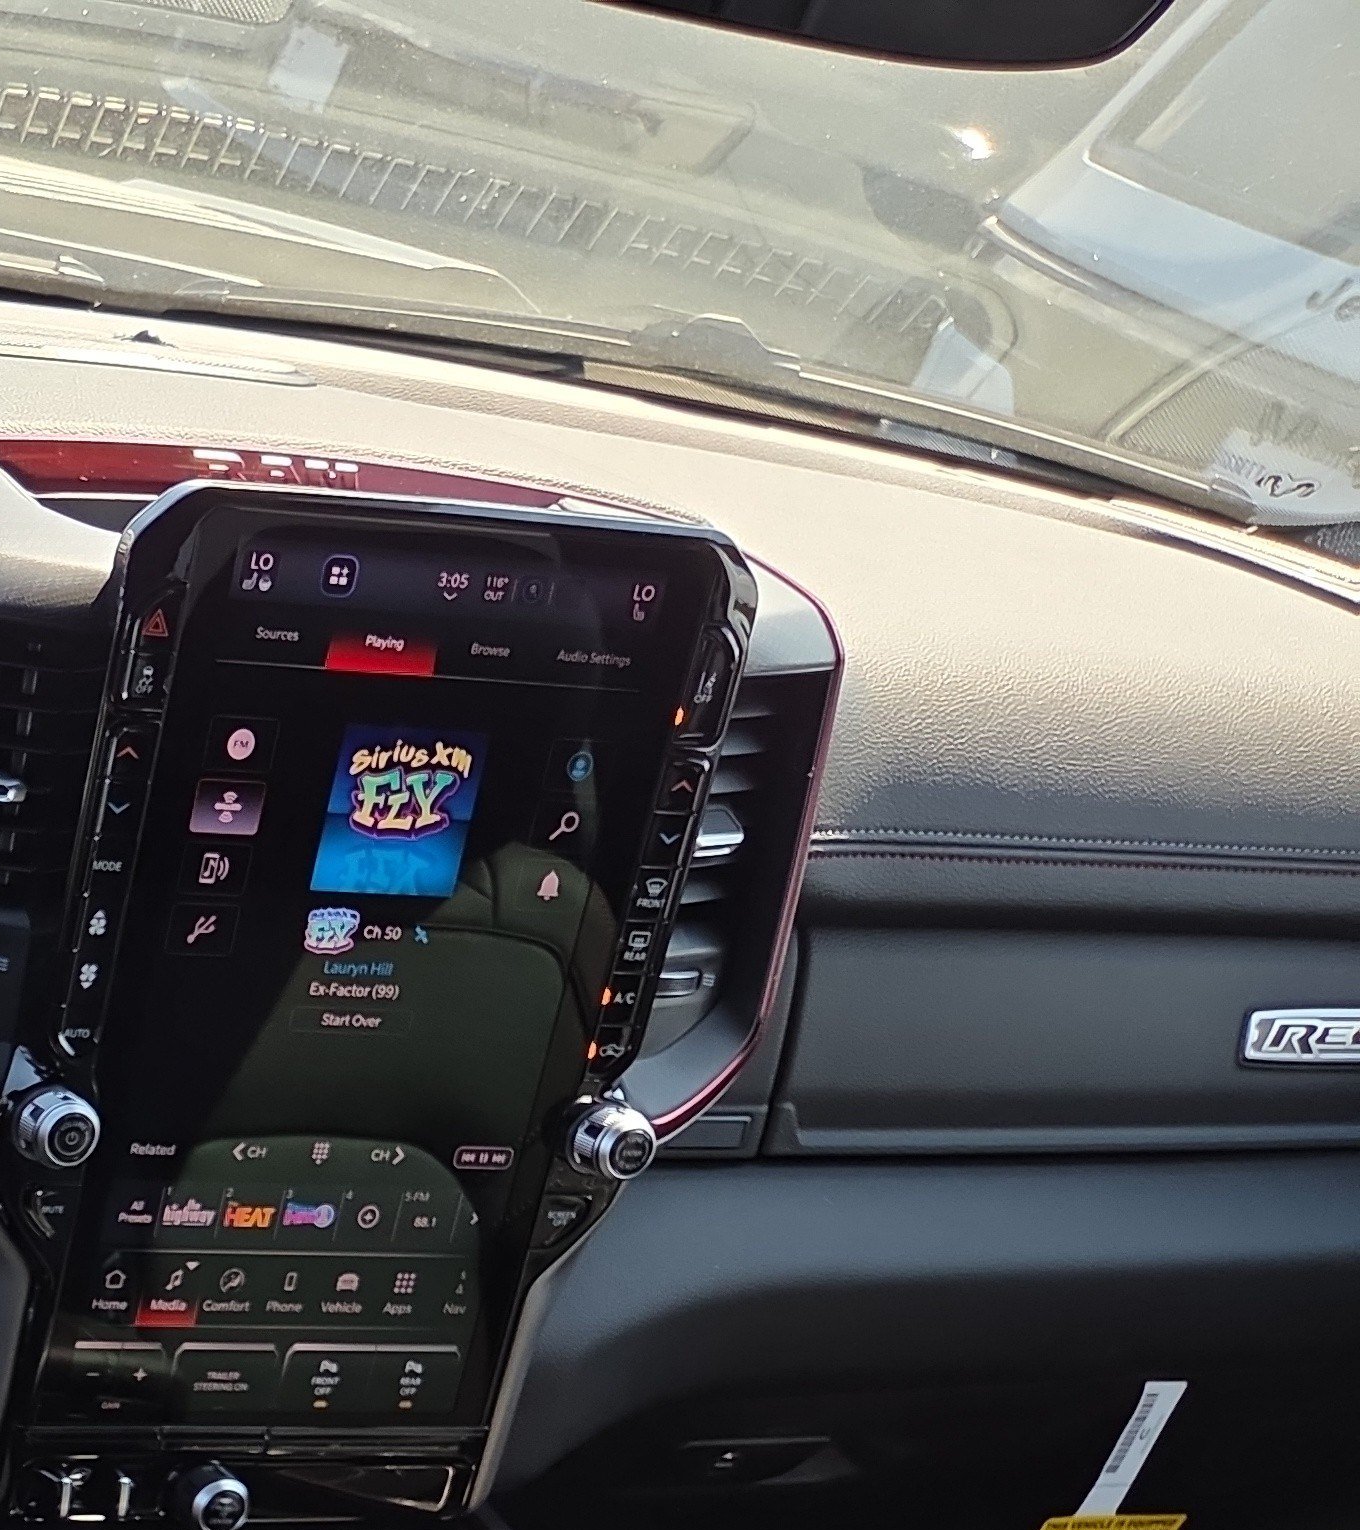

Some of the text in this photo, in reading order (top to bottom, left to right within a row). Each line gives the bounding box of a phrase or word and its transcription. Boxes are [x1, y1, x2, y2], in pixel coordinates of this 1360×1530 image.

[250, 552, 274, 571] LO
[437, 572, 469, 589] 3:05
[632, 583, 656, 601] LO
[255, 626, 299, 642] Sources
[365, 634, 404, 651] Playing
[470, 642, 510, 658] Browse
[556, 649, 632, 668] Audio Settings
[351, 768, 456, 834] FLY
[92, 861, 122, 872] MODE
[363, 926, 402, 941] Ch 50
[324, 961, 394, 977] Lauryn Hill
[309, 983, 400, 1001] Ex-Factor (99)
[320, 1013, 382, 1029] Start Over
[64, 1028, 91, 1039] AUTO
[130, 1143, 176, 1156] Related
[247, 1147, 266, 1159] CH
[370, 1150, 390, 1162] CH
[224, 1206, 277, 1227] HEAT
[92, 1299, 128, 1311] Home
[150, 1299, 186, 1311] Media
[203, 1300, 250, 1312] Comfort
[265, 1301, 303, 1313] Phone
[321, 1301, 362, 1314] Vehicle
[382, 1302, 413, 1316] Apps
[443, 1303, 467, 1315] Nav
